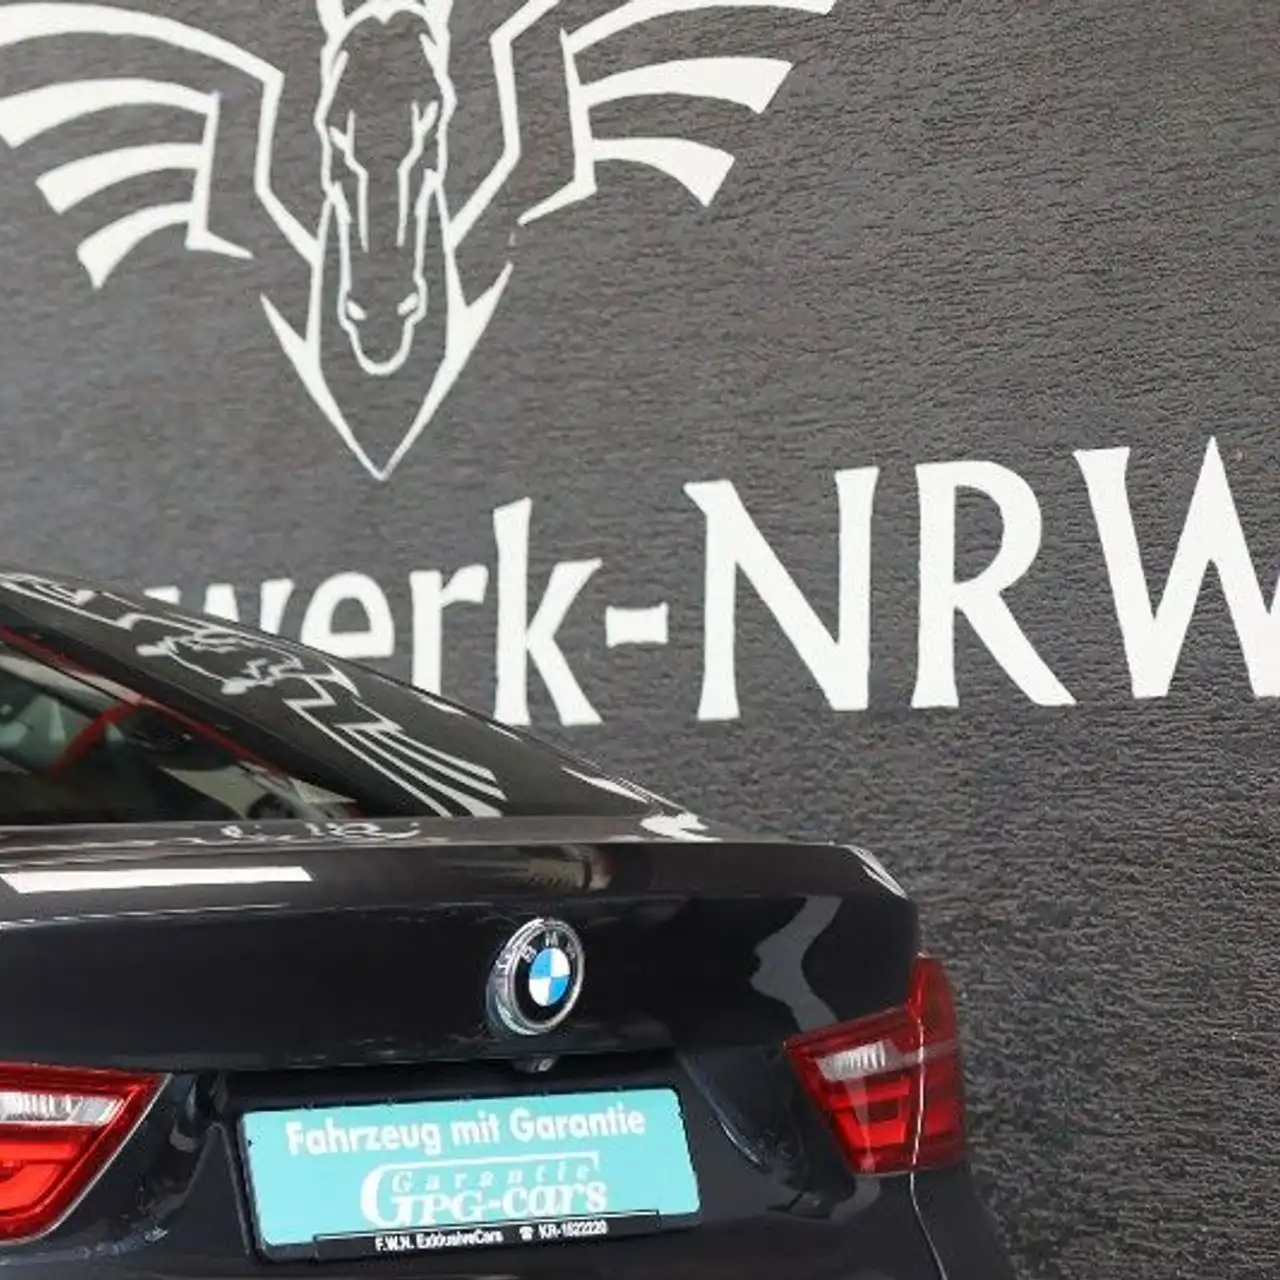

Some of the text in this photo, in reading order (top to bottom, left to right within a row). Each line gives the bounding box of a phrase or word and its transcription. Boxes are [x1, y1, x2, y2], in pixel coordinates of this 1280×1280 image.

[285, 1102, 646, 1155] Fahrzeug mit Garantie
